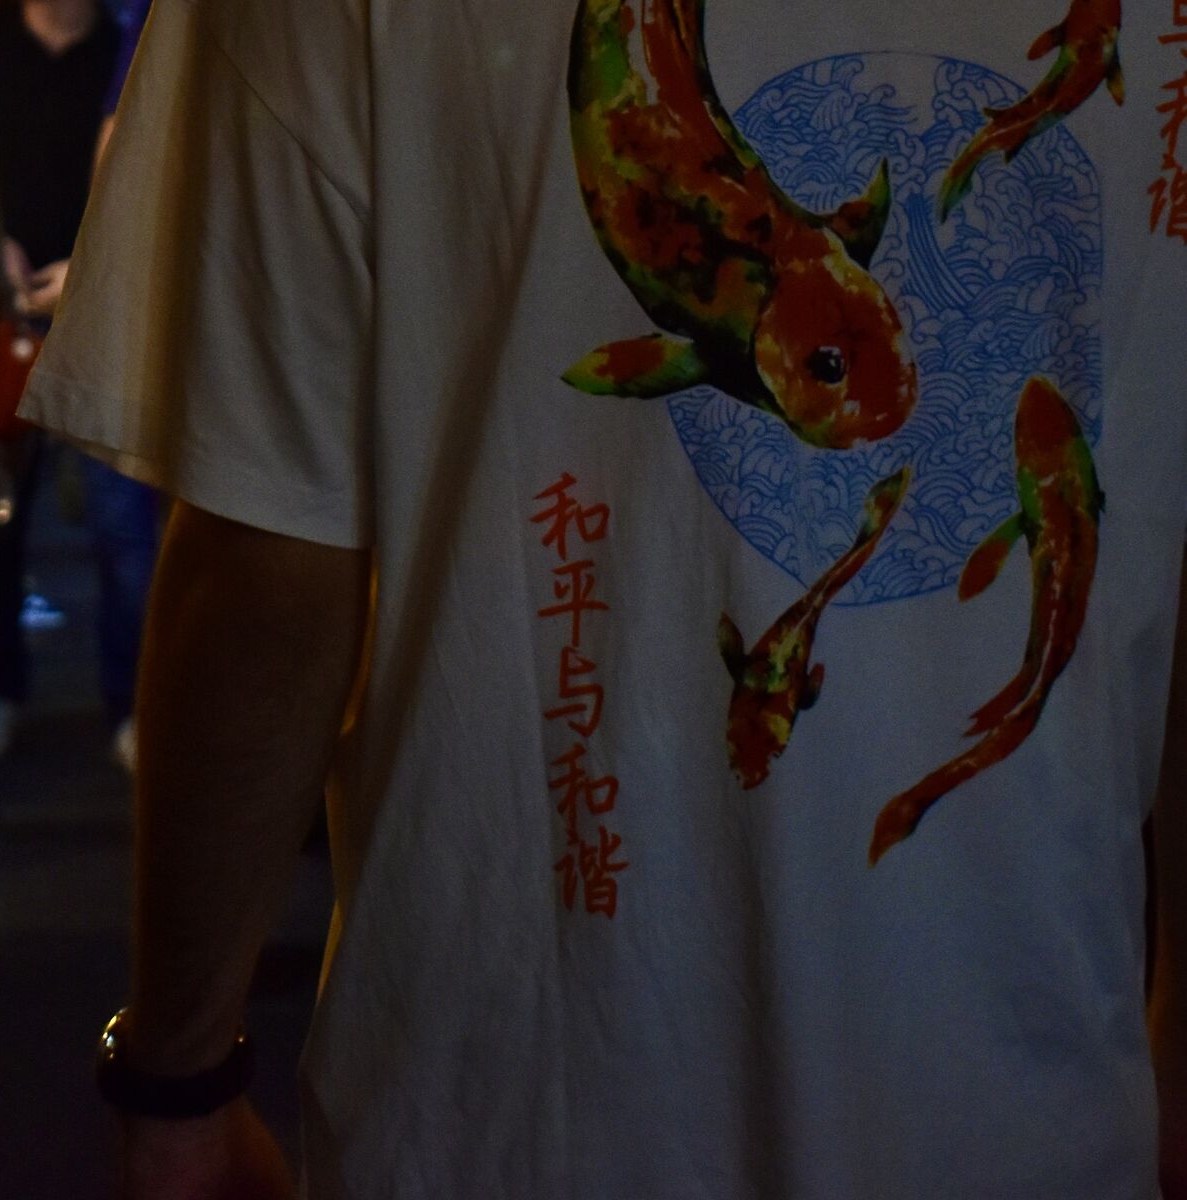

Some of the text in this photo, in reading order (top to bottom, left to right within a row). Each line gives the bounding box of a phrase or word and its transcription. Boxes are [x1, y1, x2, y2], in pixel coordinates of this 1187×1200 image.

[529, 472, 631, 921] 和平与和谐
